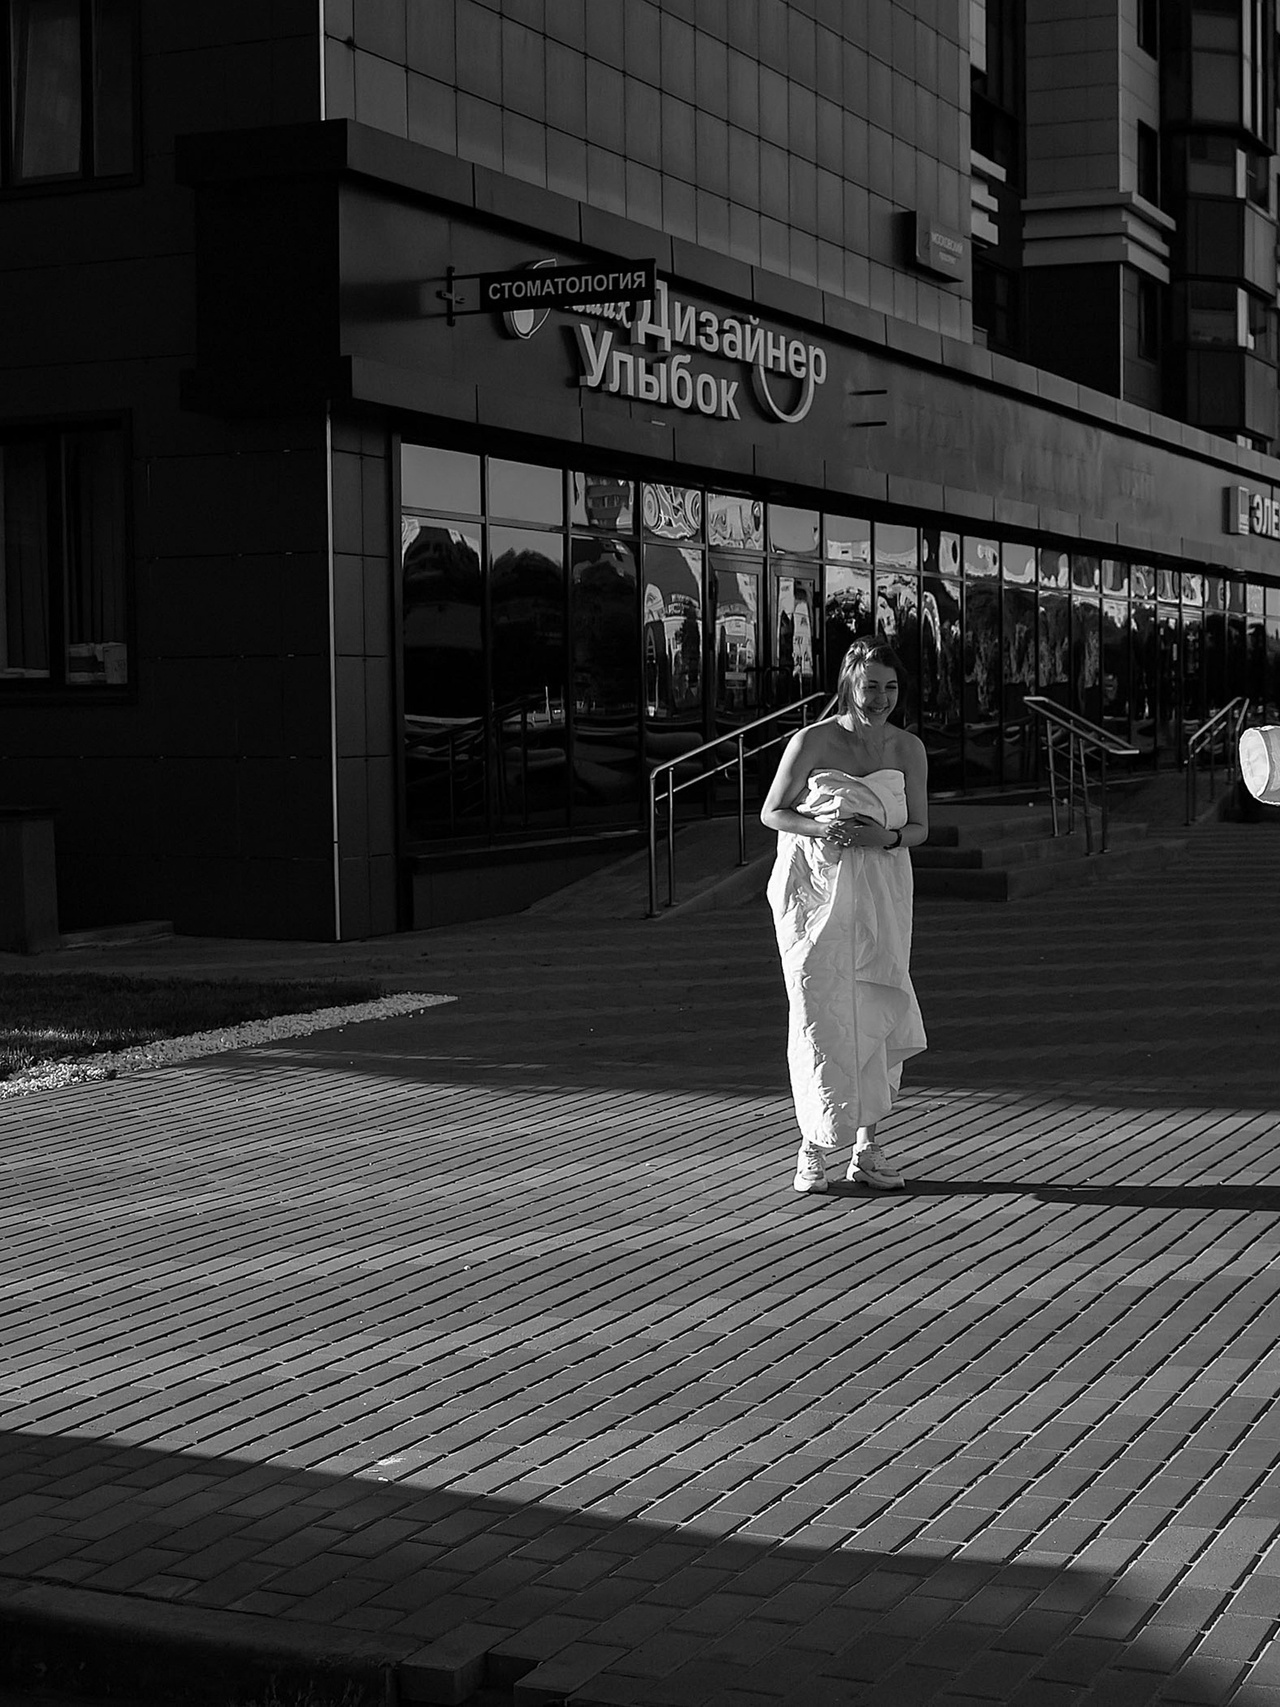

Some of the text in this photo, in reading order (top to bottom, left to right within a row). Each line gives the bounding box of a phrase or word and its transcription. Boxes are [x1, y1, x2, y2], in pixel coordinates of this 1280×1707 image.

[489, 271, 646, 300] СТОМАТОЛОГИЯ
[636, 279, 827, 385] Дизайнер
[579, 322, 741, 421] Улыбок
